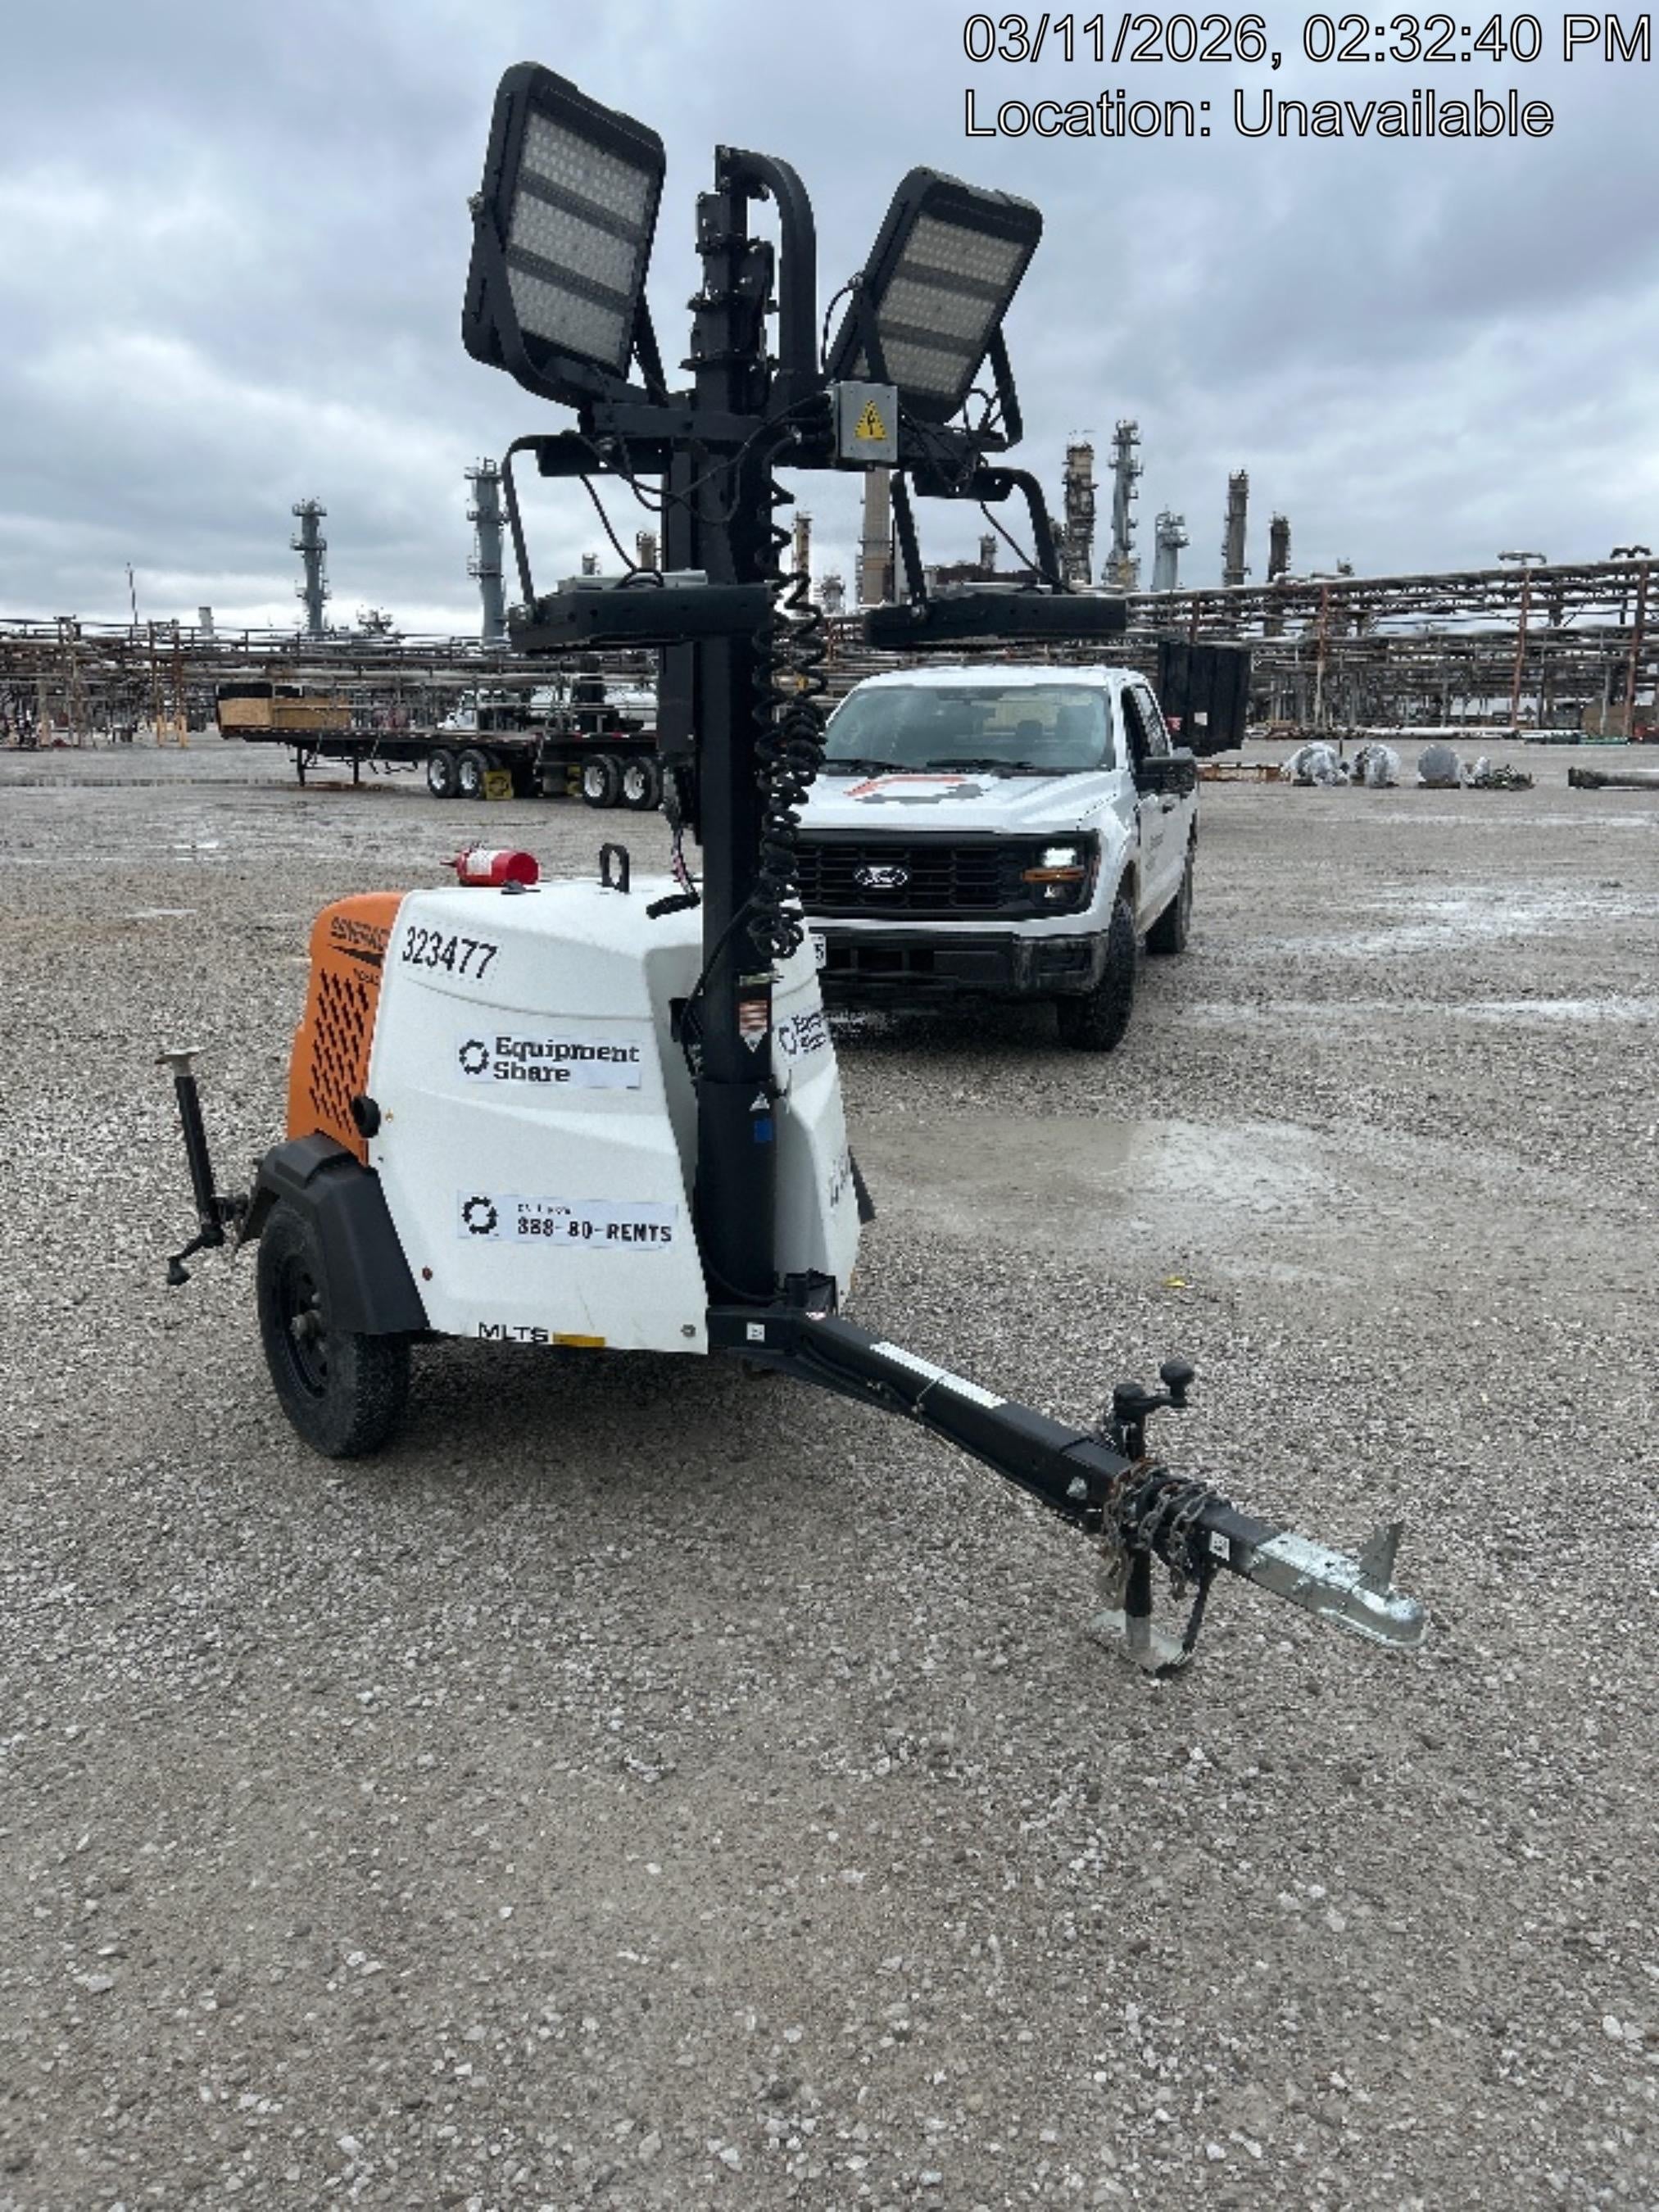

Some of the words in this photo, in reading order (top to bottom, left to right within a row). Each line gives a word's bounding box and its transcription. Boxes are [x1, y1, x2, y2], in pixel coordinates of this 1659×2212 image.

[402, 926, 498, 979] 323477
[496, 1036, 640, 1063] Equipment
[493, 1061, 570, 1082] Share
